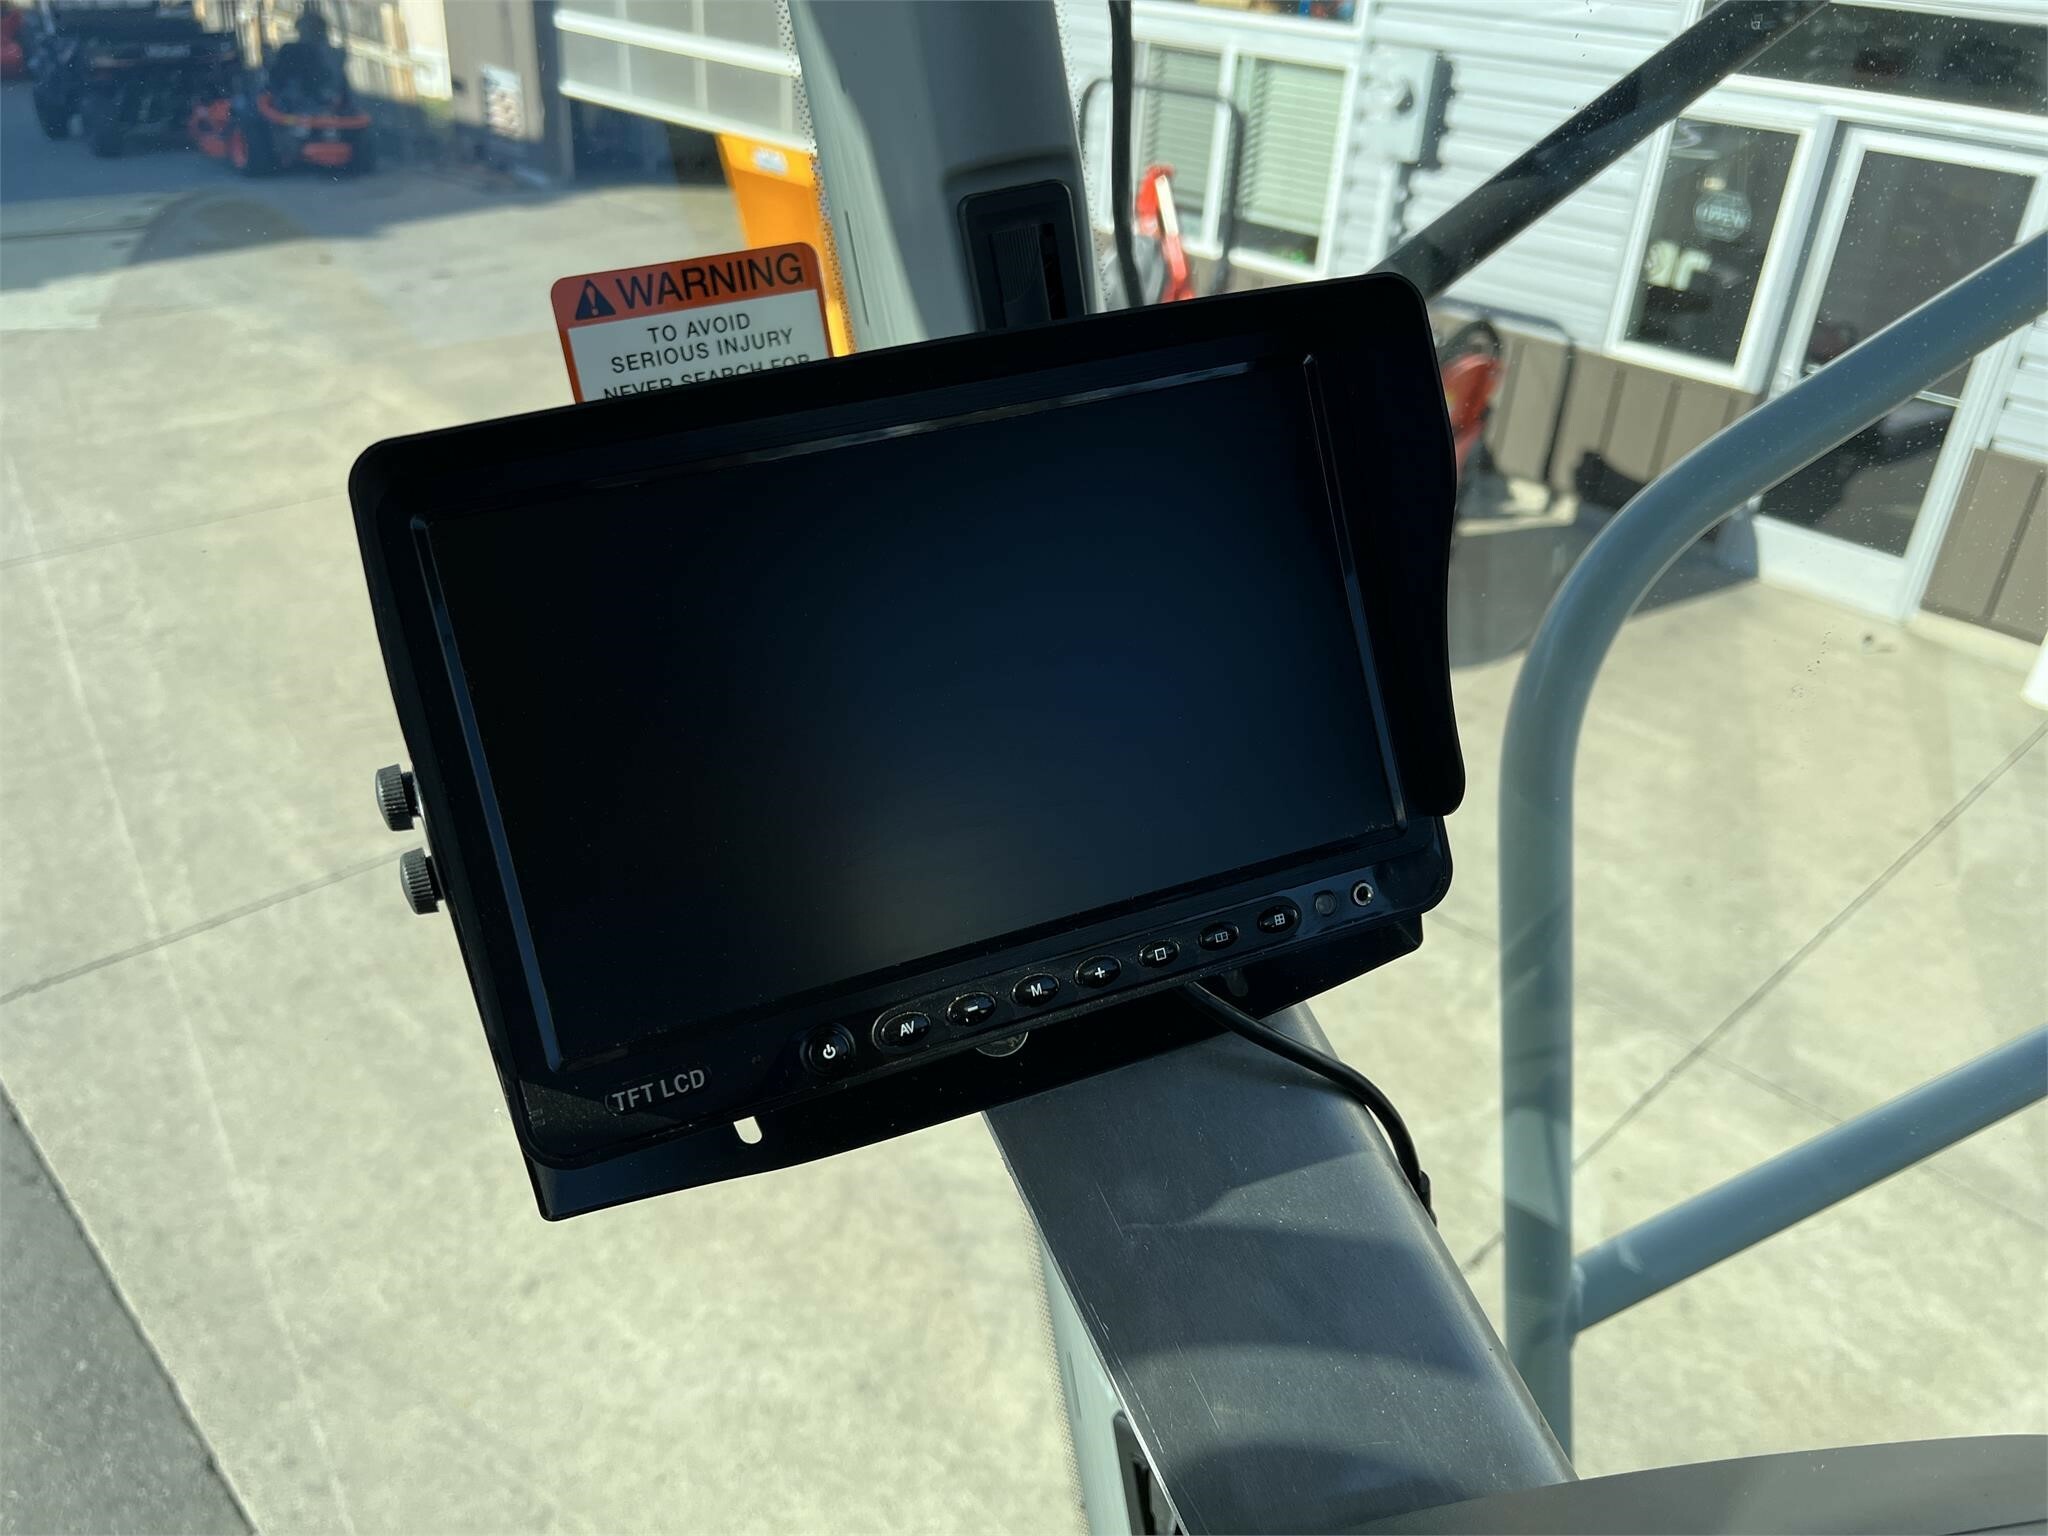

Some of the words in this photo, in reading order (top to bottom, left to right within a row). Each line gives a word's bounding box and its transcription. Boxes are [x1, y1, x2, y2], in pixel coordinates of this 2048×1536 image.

[615, 252, 804, 310] WARNING
[647, 324, 678, 345] TO
[686, 312, 751, 339] AVOID
[611, 342, 710, 374] SERIOUS
[717, 327, 793, 356] INJURY
[1030, 983, 1043, 998] M
[900, 1020, 915, 1037] AV
[611, 1082, 654, 1112] TFT
[660, 1069, 705, 1098] LCD
